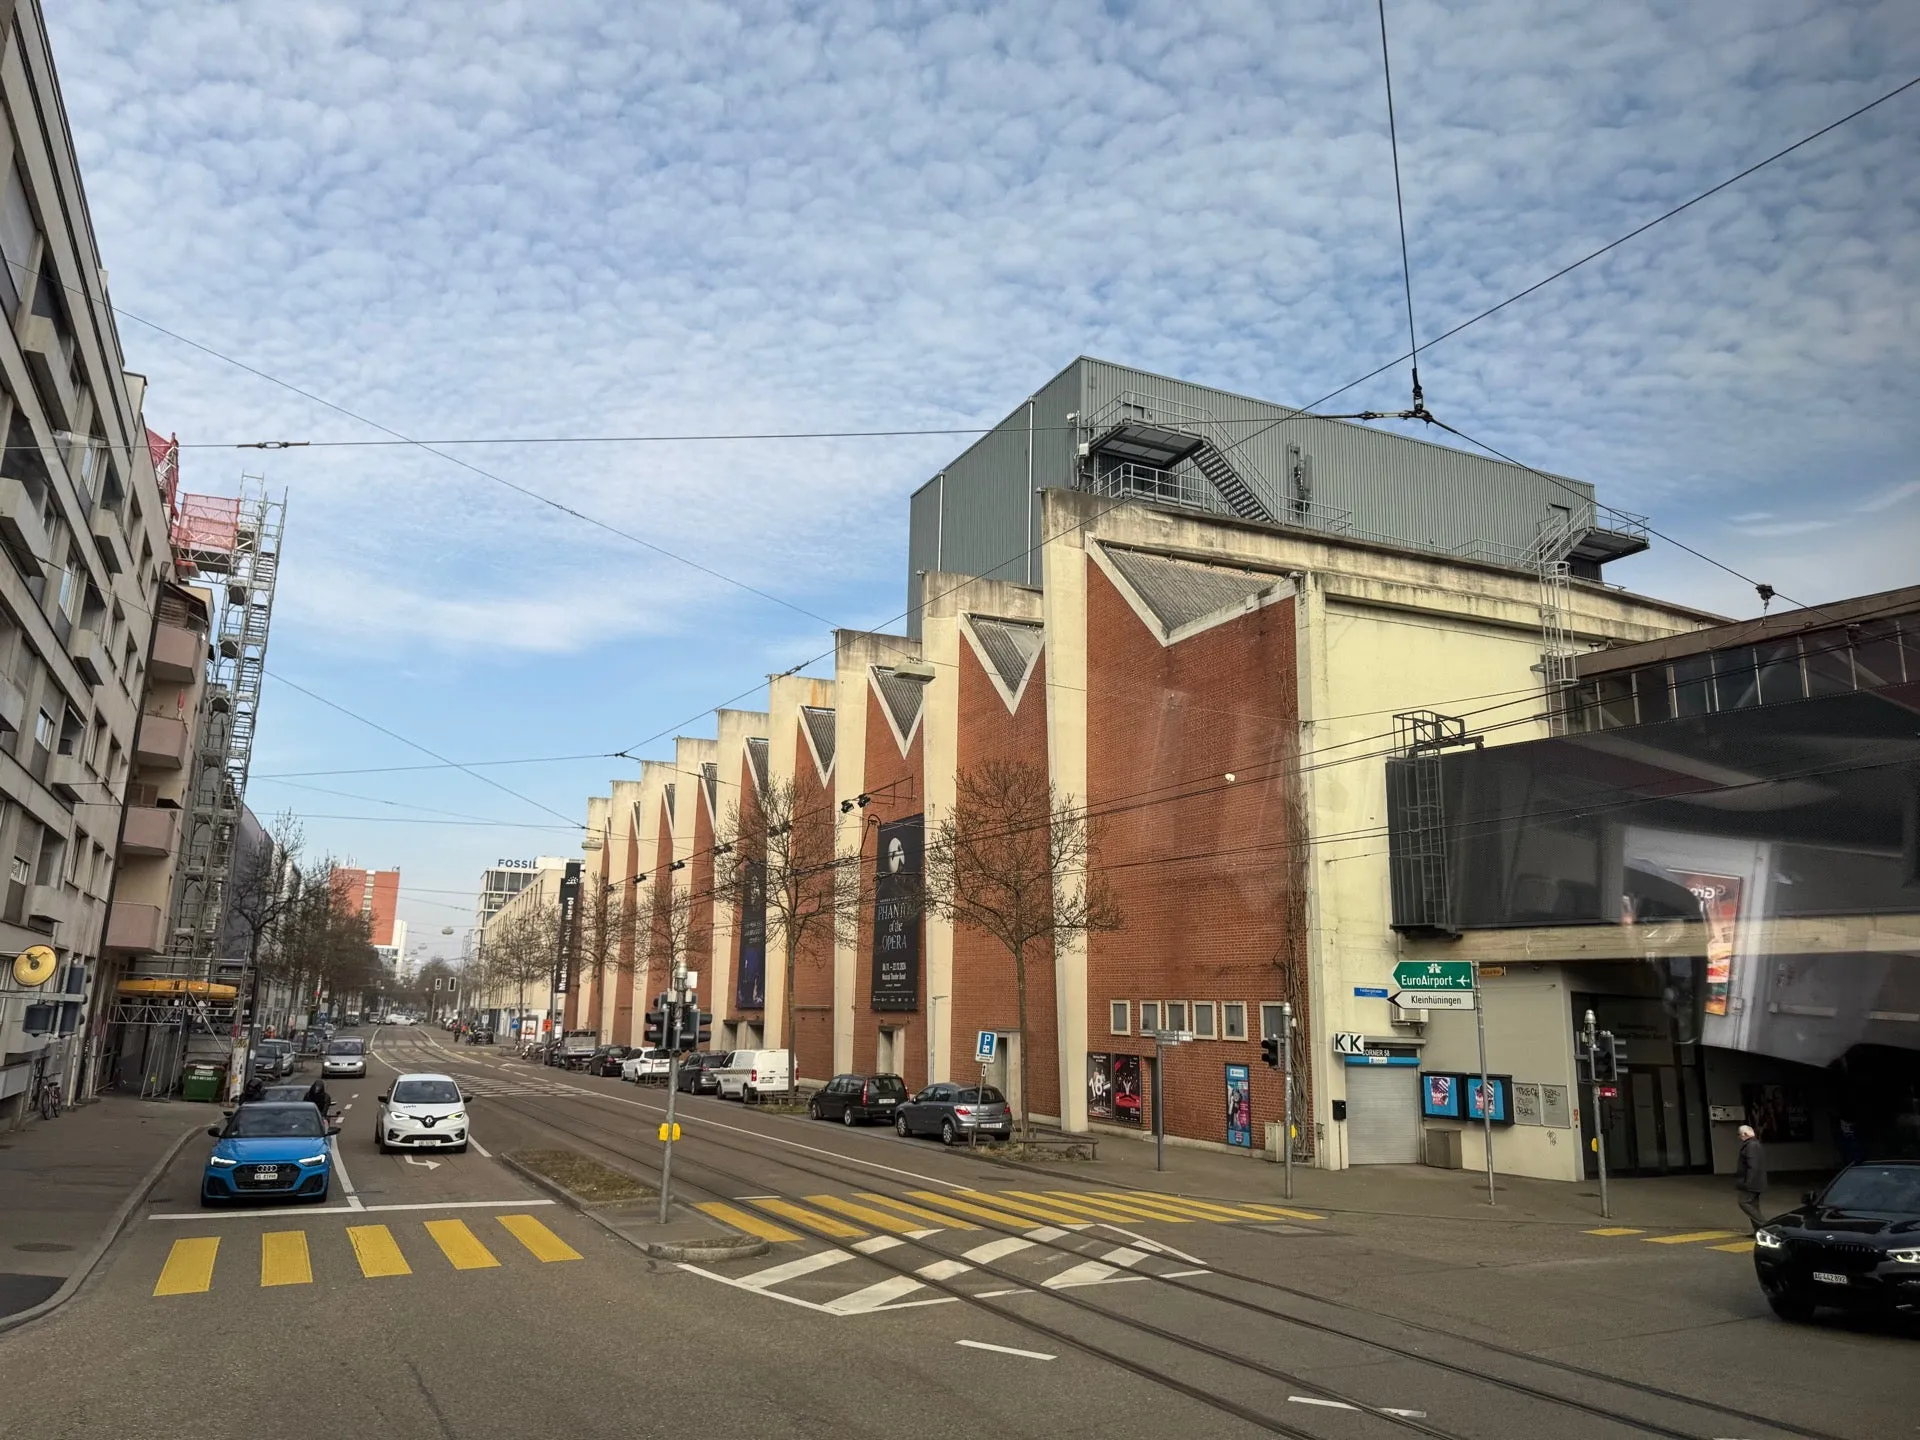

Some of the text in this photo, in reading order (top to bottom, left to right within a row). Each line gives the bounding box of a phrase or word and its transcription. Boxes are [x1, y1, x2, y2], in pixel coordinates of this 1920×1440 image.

[497, 858, 539, 869] FOSSIL
[878, 902, 916, 920] PHANT
[882, 934, 907, 951] OPERA
[1401, 975, 1453, 988] EuroAirport
[1411, 995, 1462, 1006] Kleinhüningen
[984, 1034, 991, 1045] P
